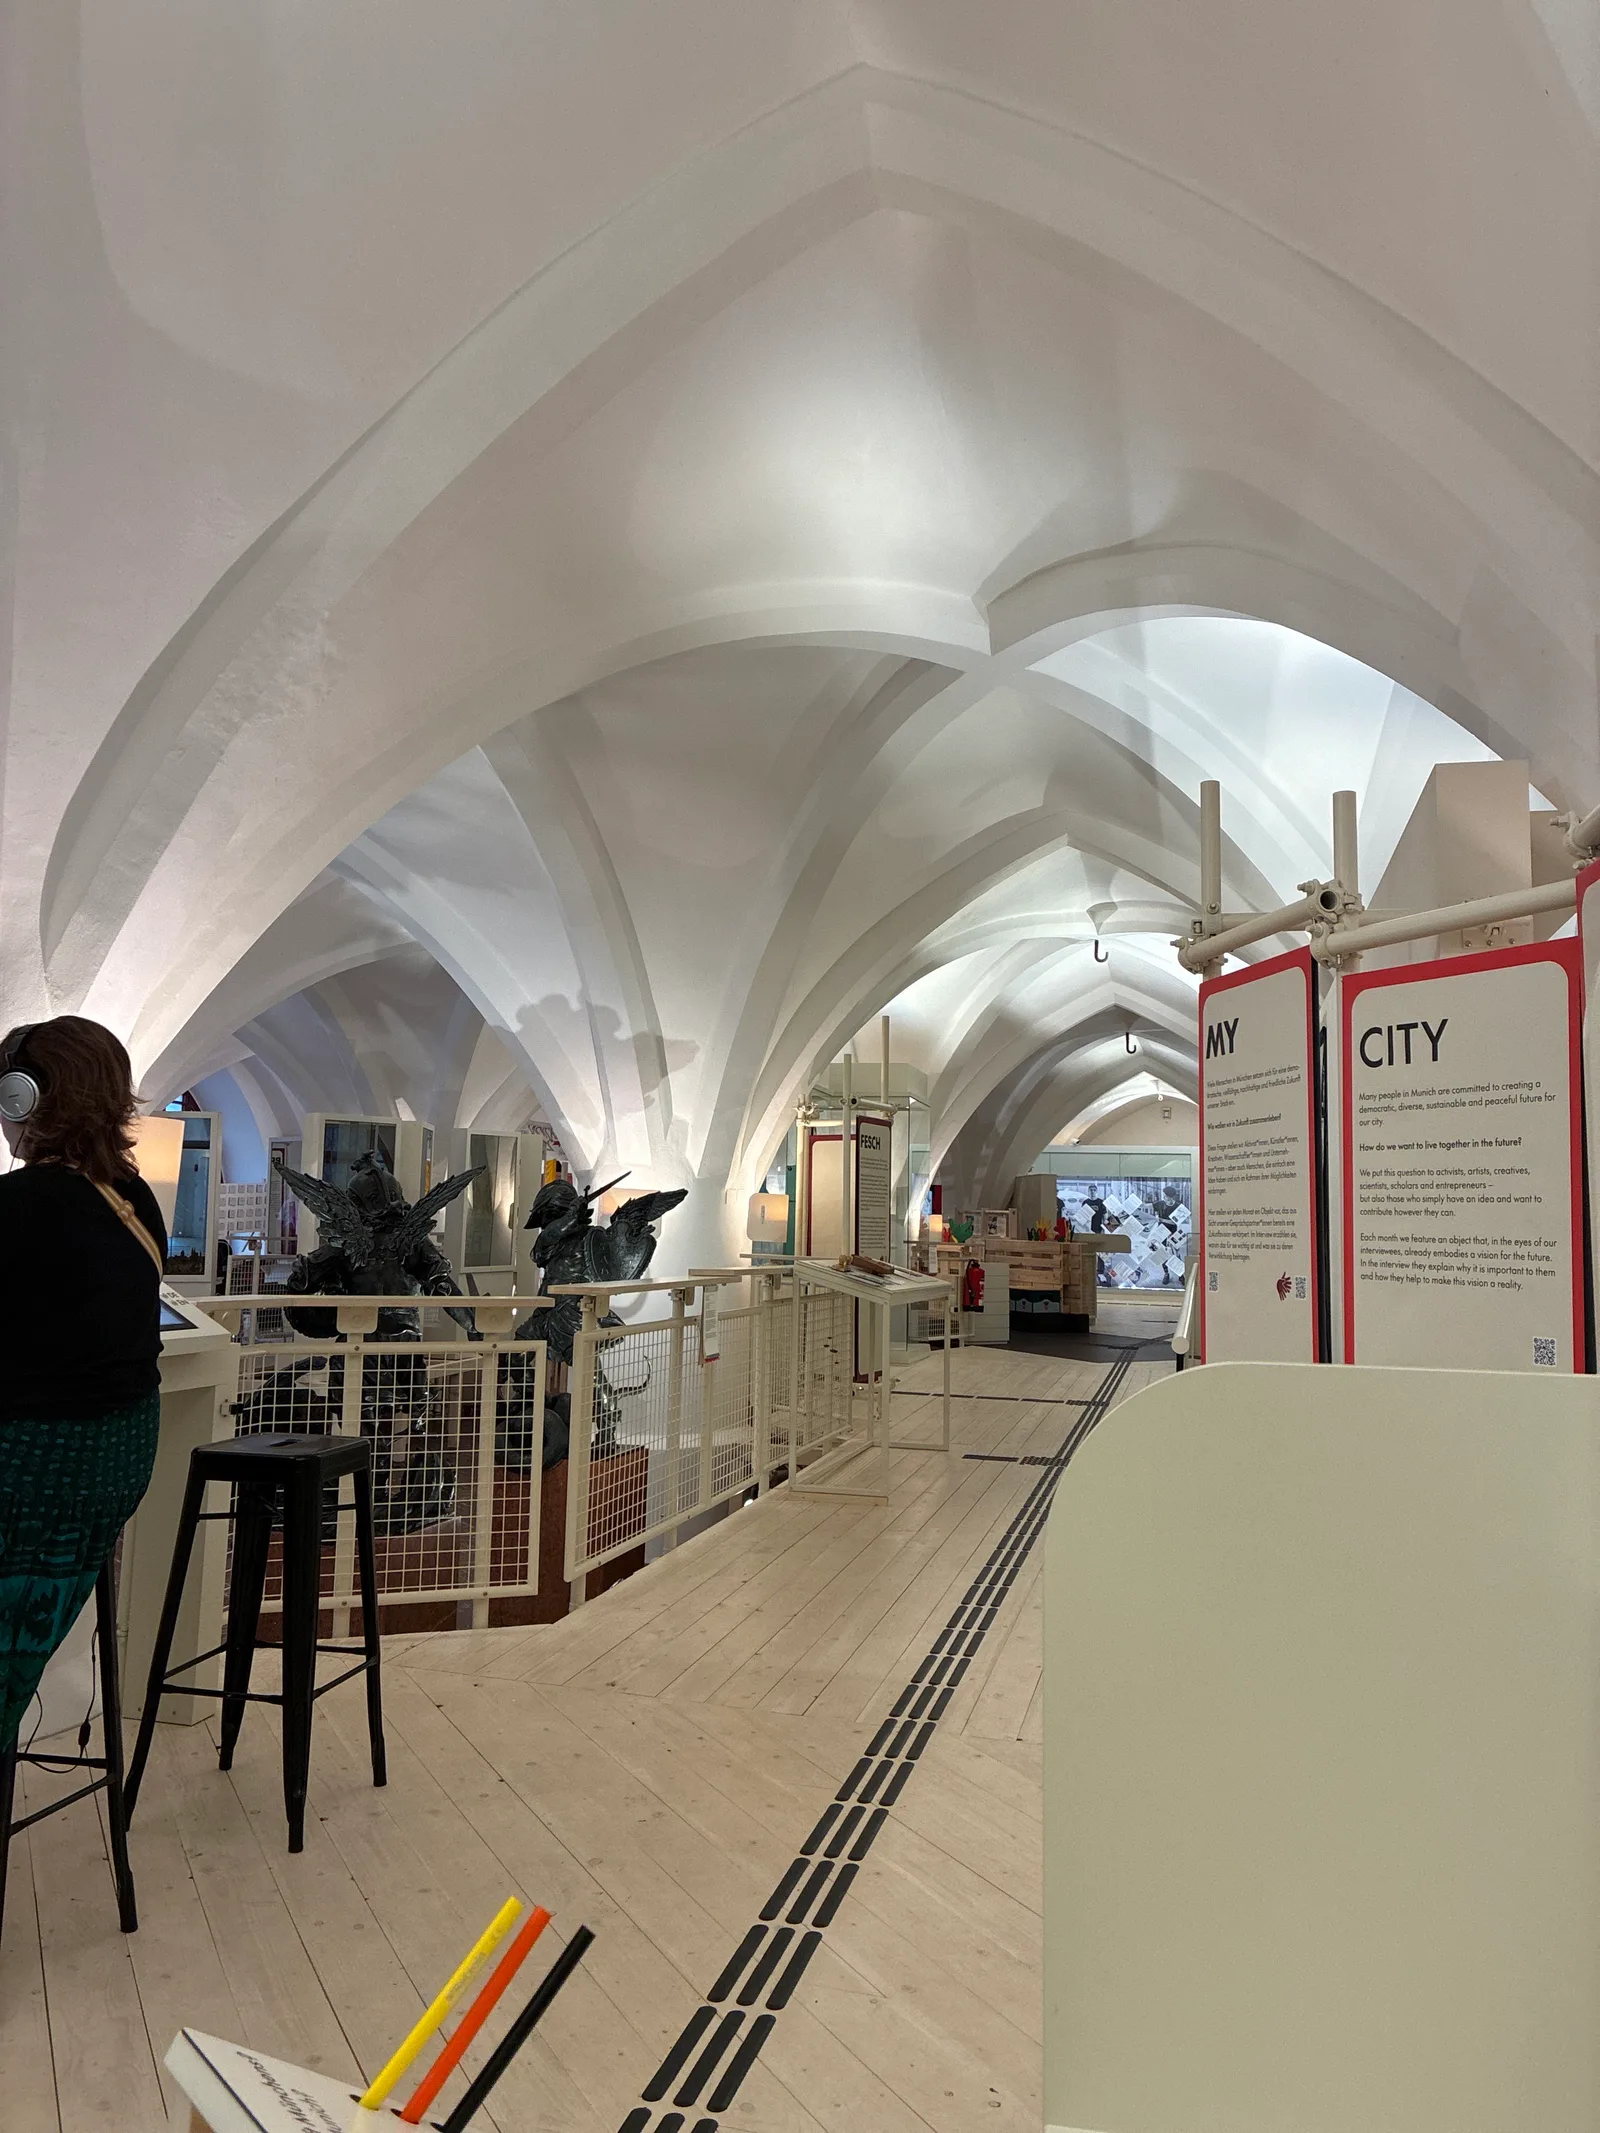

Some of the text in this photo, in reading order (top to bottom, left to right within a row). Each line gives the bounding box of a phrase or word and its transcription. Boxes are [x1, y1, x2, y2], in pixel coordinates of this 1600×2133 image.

[1206, 1017, 1239, 1059] MY
[1359, 1018, 1449, 1068] CITY
[1359, 1093, 1377, 1102] Many
[1378, 1090, 1402, 1102] people
[1403, 1090, 1410, 1098] in
[1411, 1088, 1437, 1097] Munich
[1451, 1084, 1491, 1095] committed
[1492, 1083, 1500, 1092] to
[1501, 1081, 1534, 1091] creating
[1359, 1093, 1556, 1113] democratic, diverse, sustainable and peaceful future for
[1371, 1117, 1384, 1127] city.
[861, 1134, 881, 1151] FESCH
[1359, 1143, 1374, 1151] How
[1376, 1142, 1385, 1151] do
[1398, 1141, 1415, 1150] want
[1416, 1141, 1424, 1149] to
[1425, 1141, 1438, 1149] live
[1439, 1139, 1470, 1150] together
[1472, 1139, 1479, 1147] in
[1481, 1138, 1493, 1147] the
[1495, 1137, 1522, 1146] future?
[1360, 1167, 1531, 1179] We put this question to activists, artists, creatives,
[1360, 1181, 1390, 1190] scientists,
[1391, 1181, 1419, 1189] scholars
[1420, 1181, 1434, 1189] and
[1436, 1181, 1487, 1191] entrepreneurs
[1360, 1194, 1370, 1203] but
[1371, 1194, 1385, 1203] also
[1386, 1194, 1405, 1203] those
[1406, 1194, 1421, 1203] who
[1422, 1195, 1445, 1205] simply
[1446, 1195, 1465, 1203] have
[1478, 1195, 1495, 1203] idea
[1496, 1195, 1512, 1203] and
[1513, 1195, 1532, 1203] want
[1534, 1195, 1542, 1203] to
[1360, 1208, 1393, 1216] contribute
[1394, 1208, 1423, 1216] however
[1424, 1208, 1439, 1219] they
[1360, 1233, 1376, 1242] Each
[1377, 1234, 1399, 1242] month
[1411, 1234, 1437, 1243] feature
[1449, 1235, 1472, 1246] object
[1473, 1236, 1491, 1246] that,
[1491, 1236, 1499, 1245] in
[1500, 1237, 1513, 1246] the
[1514, 1240, 1532, 1248] eyes
[1534, 1238, 1542, 1247] of
[1360, 1246, 1404, 1257] interviewees,
[1404, 1248, 1432, 1259] already
[1433, 1249, 1469, 1259] embodies
[1477, 1251, 1499, 1260] vision
[1500, 1251, 1511, 1260] for
[1513, 1252, 1526, 1261] the
[1527, 1253, 1554, 1262] future.
[1360, 1258, 1556, 1276] In the interview they explain why it is important to them
[1360, 1272, 1374, 1281] and
[1375, 1273, 1389, 1282] how
[1390, 1274, 1405, 1285] they
[1406, 1275, 1422, 1286] help
[1423, 1276, 1430, 1285] to
[1431, 1277, 1452, 1286] make
[1453, 1277, 1466, 1287] this
[1467, 1278, 1489, 1288] vision
[1497, 1281, 1524, 1292] reality.
[291, 2089, 345, 2133] unich?
